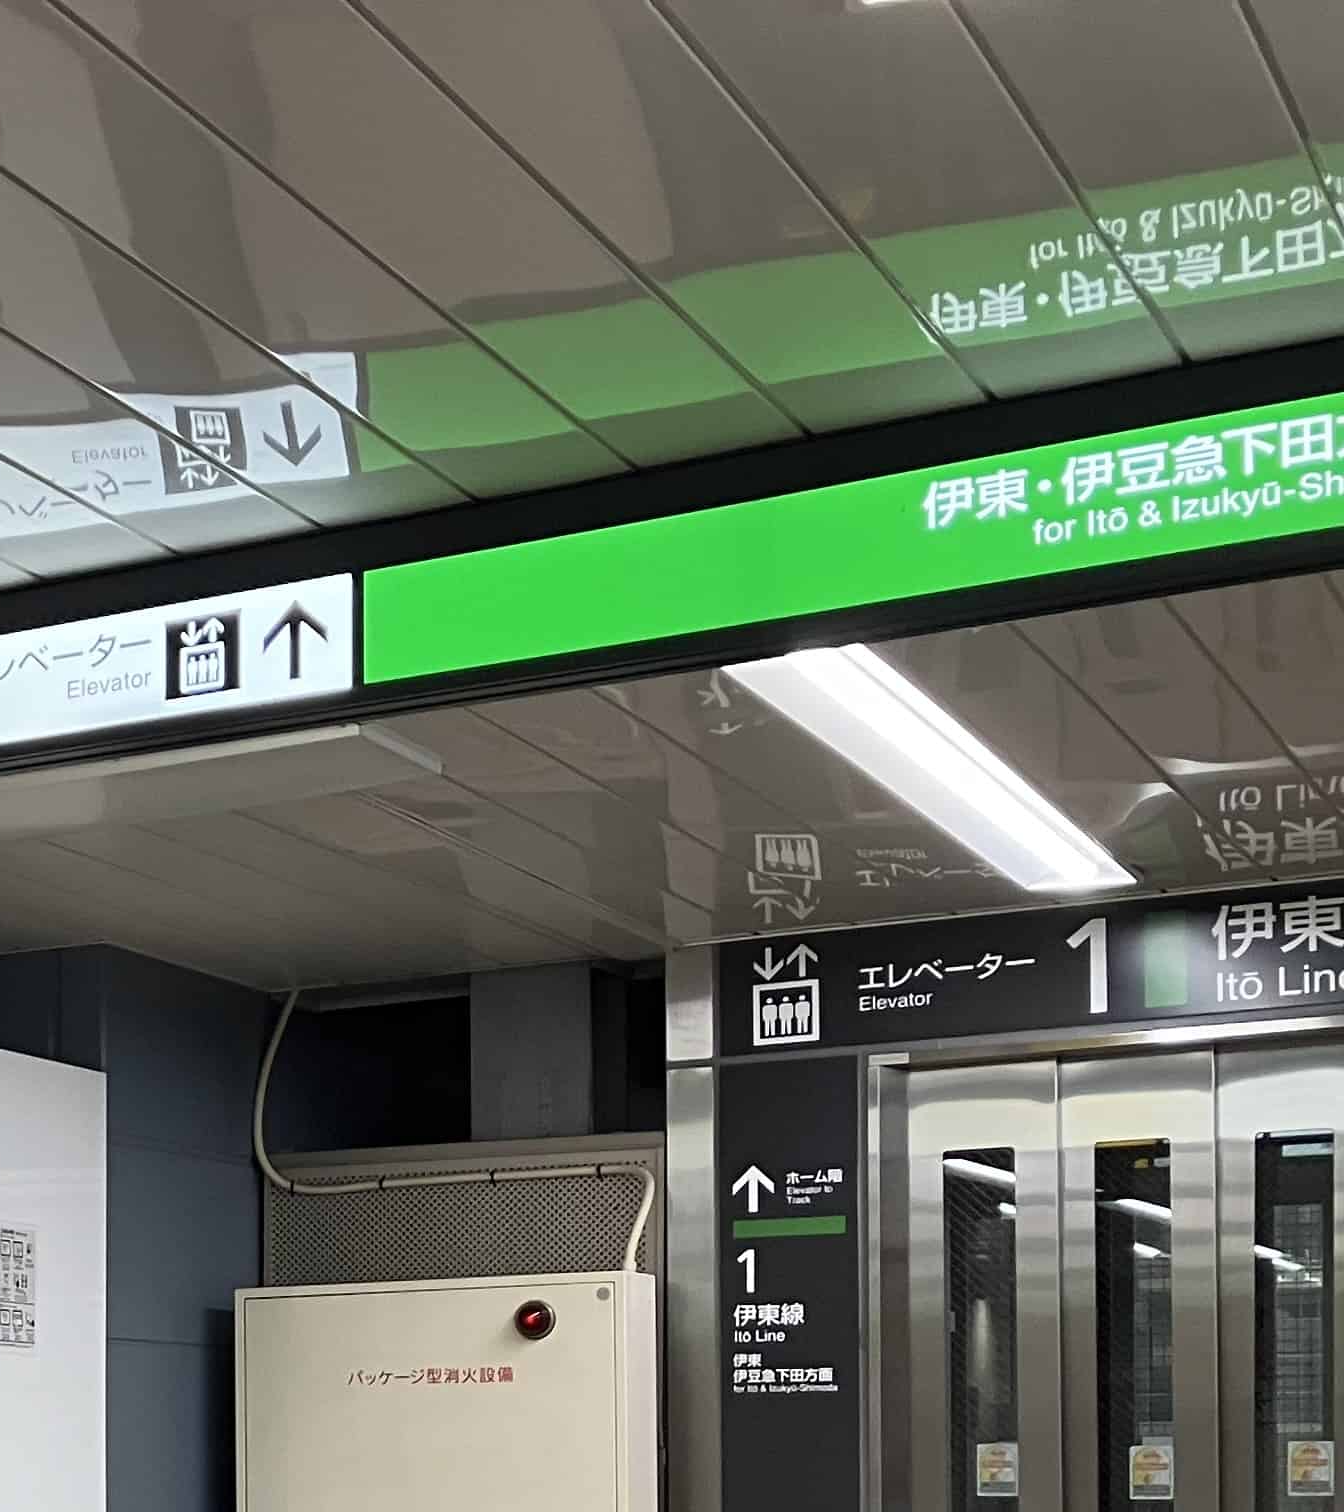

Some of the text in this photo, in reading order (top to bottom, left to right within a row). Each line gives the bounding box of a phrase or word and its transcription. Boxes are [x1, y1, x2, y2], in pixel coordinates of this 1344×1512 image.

[1032, 517, 1077, 546] for
[1086, 504, 1129, 537] Itō
[1138, 500, 1162, 529] &
[66, 668, 152, 701] Elevator
[858, 950, 1037, 990] エレベーター
[1065, 916, 1109, 1015] 1
[858, 991, 933, 1013] Elevator
[1216, 971, 1264, 1003] Itō
[736, 1248, 756, 1294] 1
[733, 1302, 805, 1327] 伊東線
[755, 1330, 786, 1343] Line
[733, 1353, 762, 1368] 伊東
[733, 1367, 834, 1383] 伊豆急下田方面
[348, 1367, 514, 1387] パッケージ型消火設備
